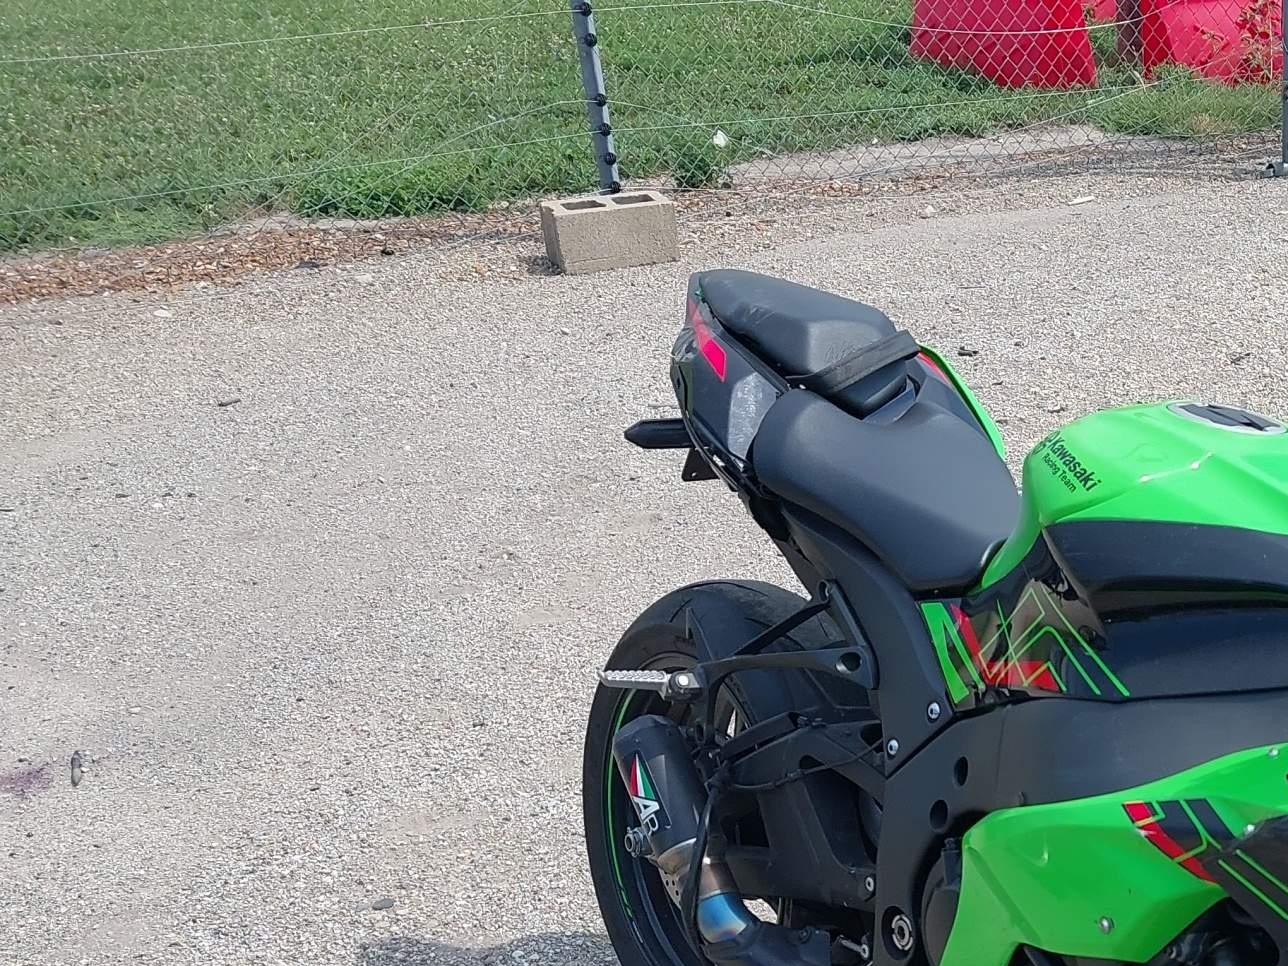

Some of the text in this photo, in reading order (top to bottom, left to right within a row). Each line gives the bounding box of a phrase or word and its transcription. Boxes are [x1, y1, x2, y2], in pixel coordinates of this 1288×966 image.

[1042, 452, 1077, 494] Racing Team
[1047, 436, 1102, 492] Kawasaki
